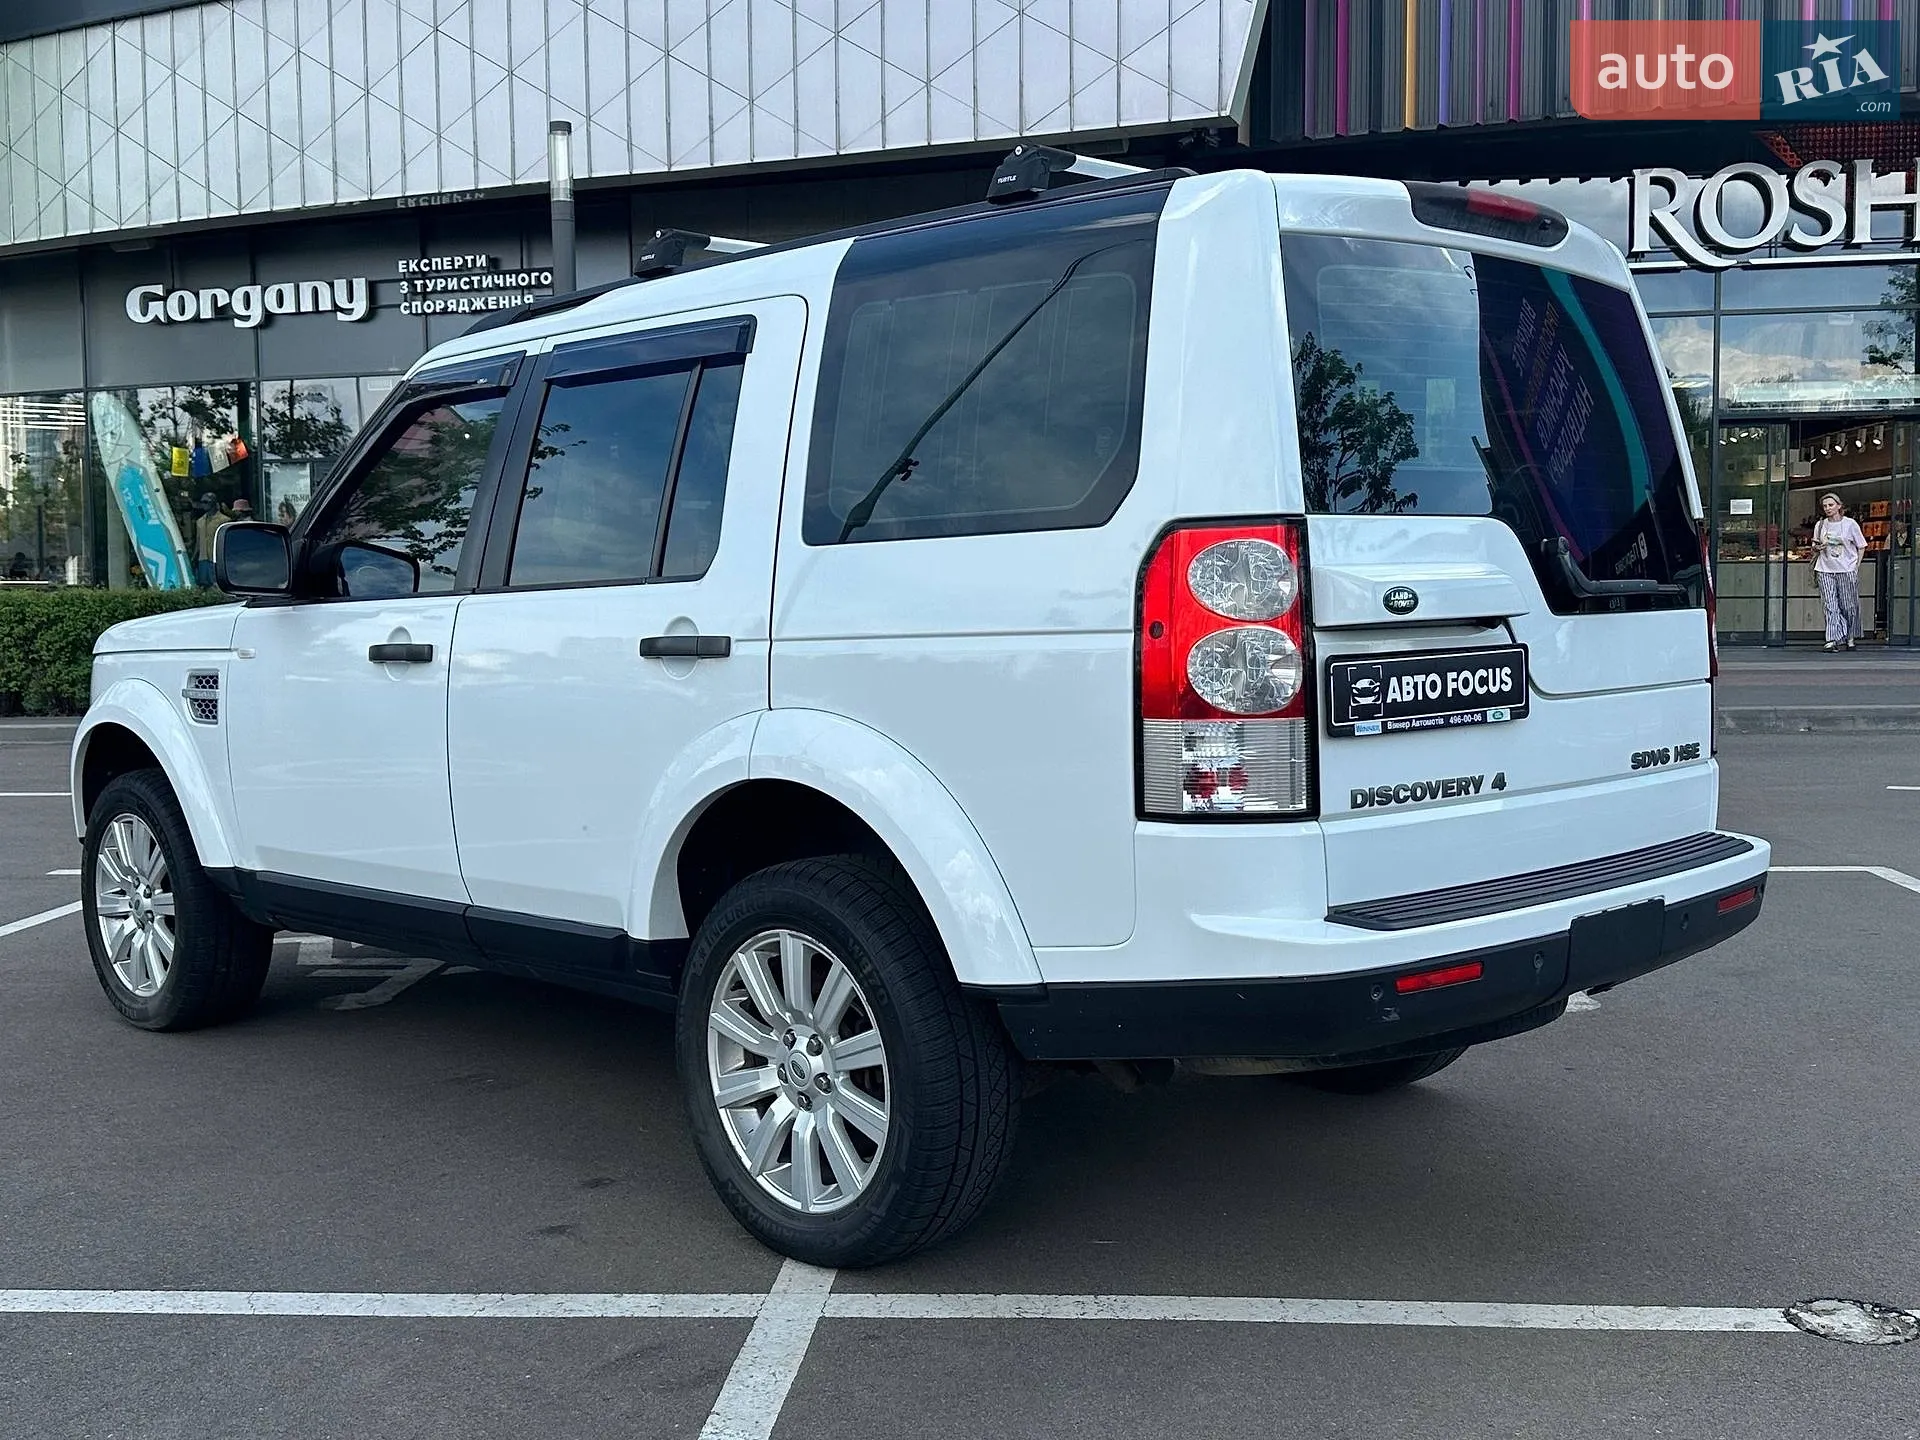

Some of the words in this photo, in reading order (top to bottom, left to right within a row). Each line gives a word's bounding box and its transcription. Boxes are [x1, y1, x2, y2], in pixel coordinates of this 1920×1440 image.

[997, 175, 1017, 184] TURTLE
[1630, 158, 1920, 268] ROSH
[398, 254, 487, 273] ЕКСПЕРТИ
[414, 271, 553, 293] ТУРИСТИЧНОГО
[125, 277, 369, 328] Gorgany
[400, 294, 535, 315] СПОРЯДЖЕННЯ
[1390, 591, 1409, 600] LAND
[1446, 666, 1512, 698] FOCUS
[1449, 713, 1482, 724] 496-00-06
[1631, 749, 1670, 770] SDV6
[1673, 742, 1701, 763] HSE
[1350, 774, 1484, 809] DISCOVERY
[1490, 772, 1507, 792] 4
